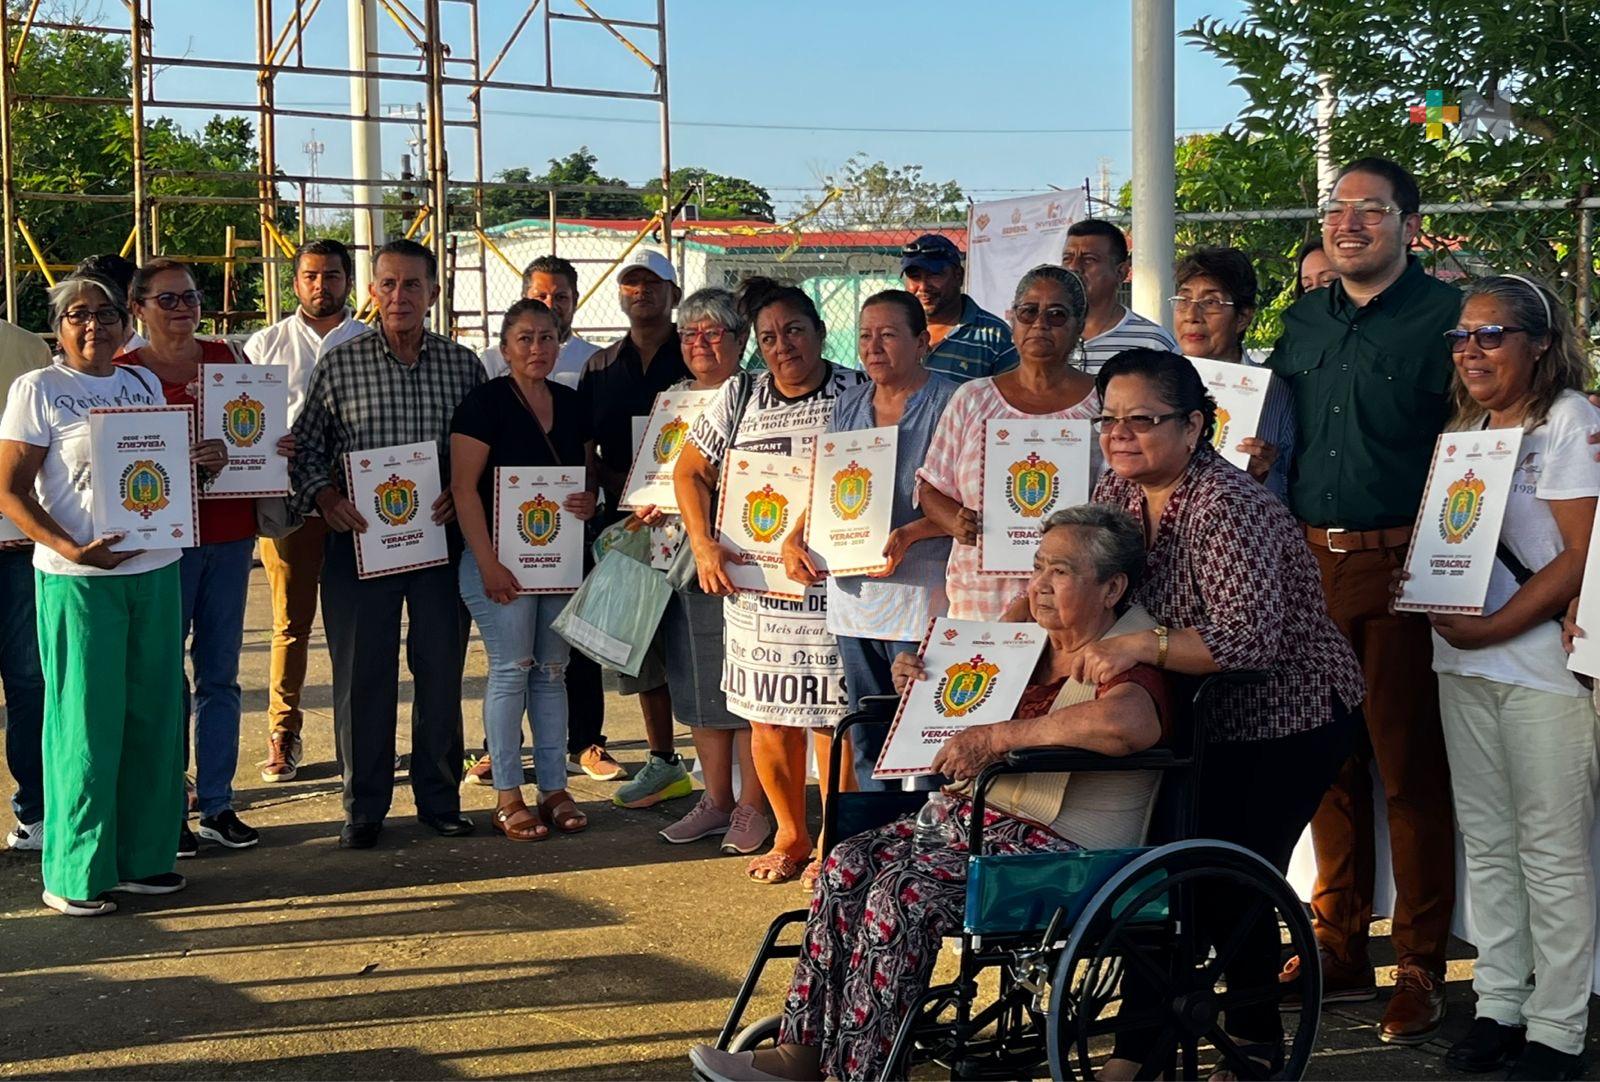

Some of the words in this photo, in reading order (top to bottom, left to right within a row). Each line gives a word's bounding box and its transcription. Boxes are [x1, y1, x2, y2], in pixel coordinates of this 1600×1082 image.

[759, 407, 807, 423] interpret
[761, 419, 790, 430] note
[792, 416, 820, 427] may
[117, 440, 166, 449] VERACRUZ
[381, 531, 424, 545] VERACRUZ
[829, 530, 871, 541] VERACRUZ
[518, 556, 562, 564] VERACRUZ
[739, 552, 785, 565] VERACRUZ
[1429, 559, 1472, 569] VERACRUZ
[763, 622, 791, 635] Meis
[795, 625, 824, 636] dicat
[751, 646, 781, 663] Old
[789, 650, 838, 666] News
[755, 702, 804, 717] interpret
